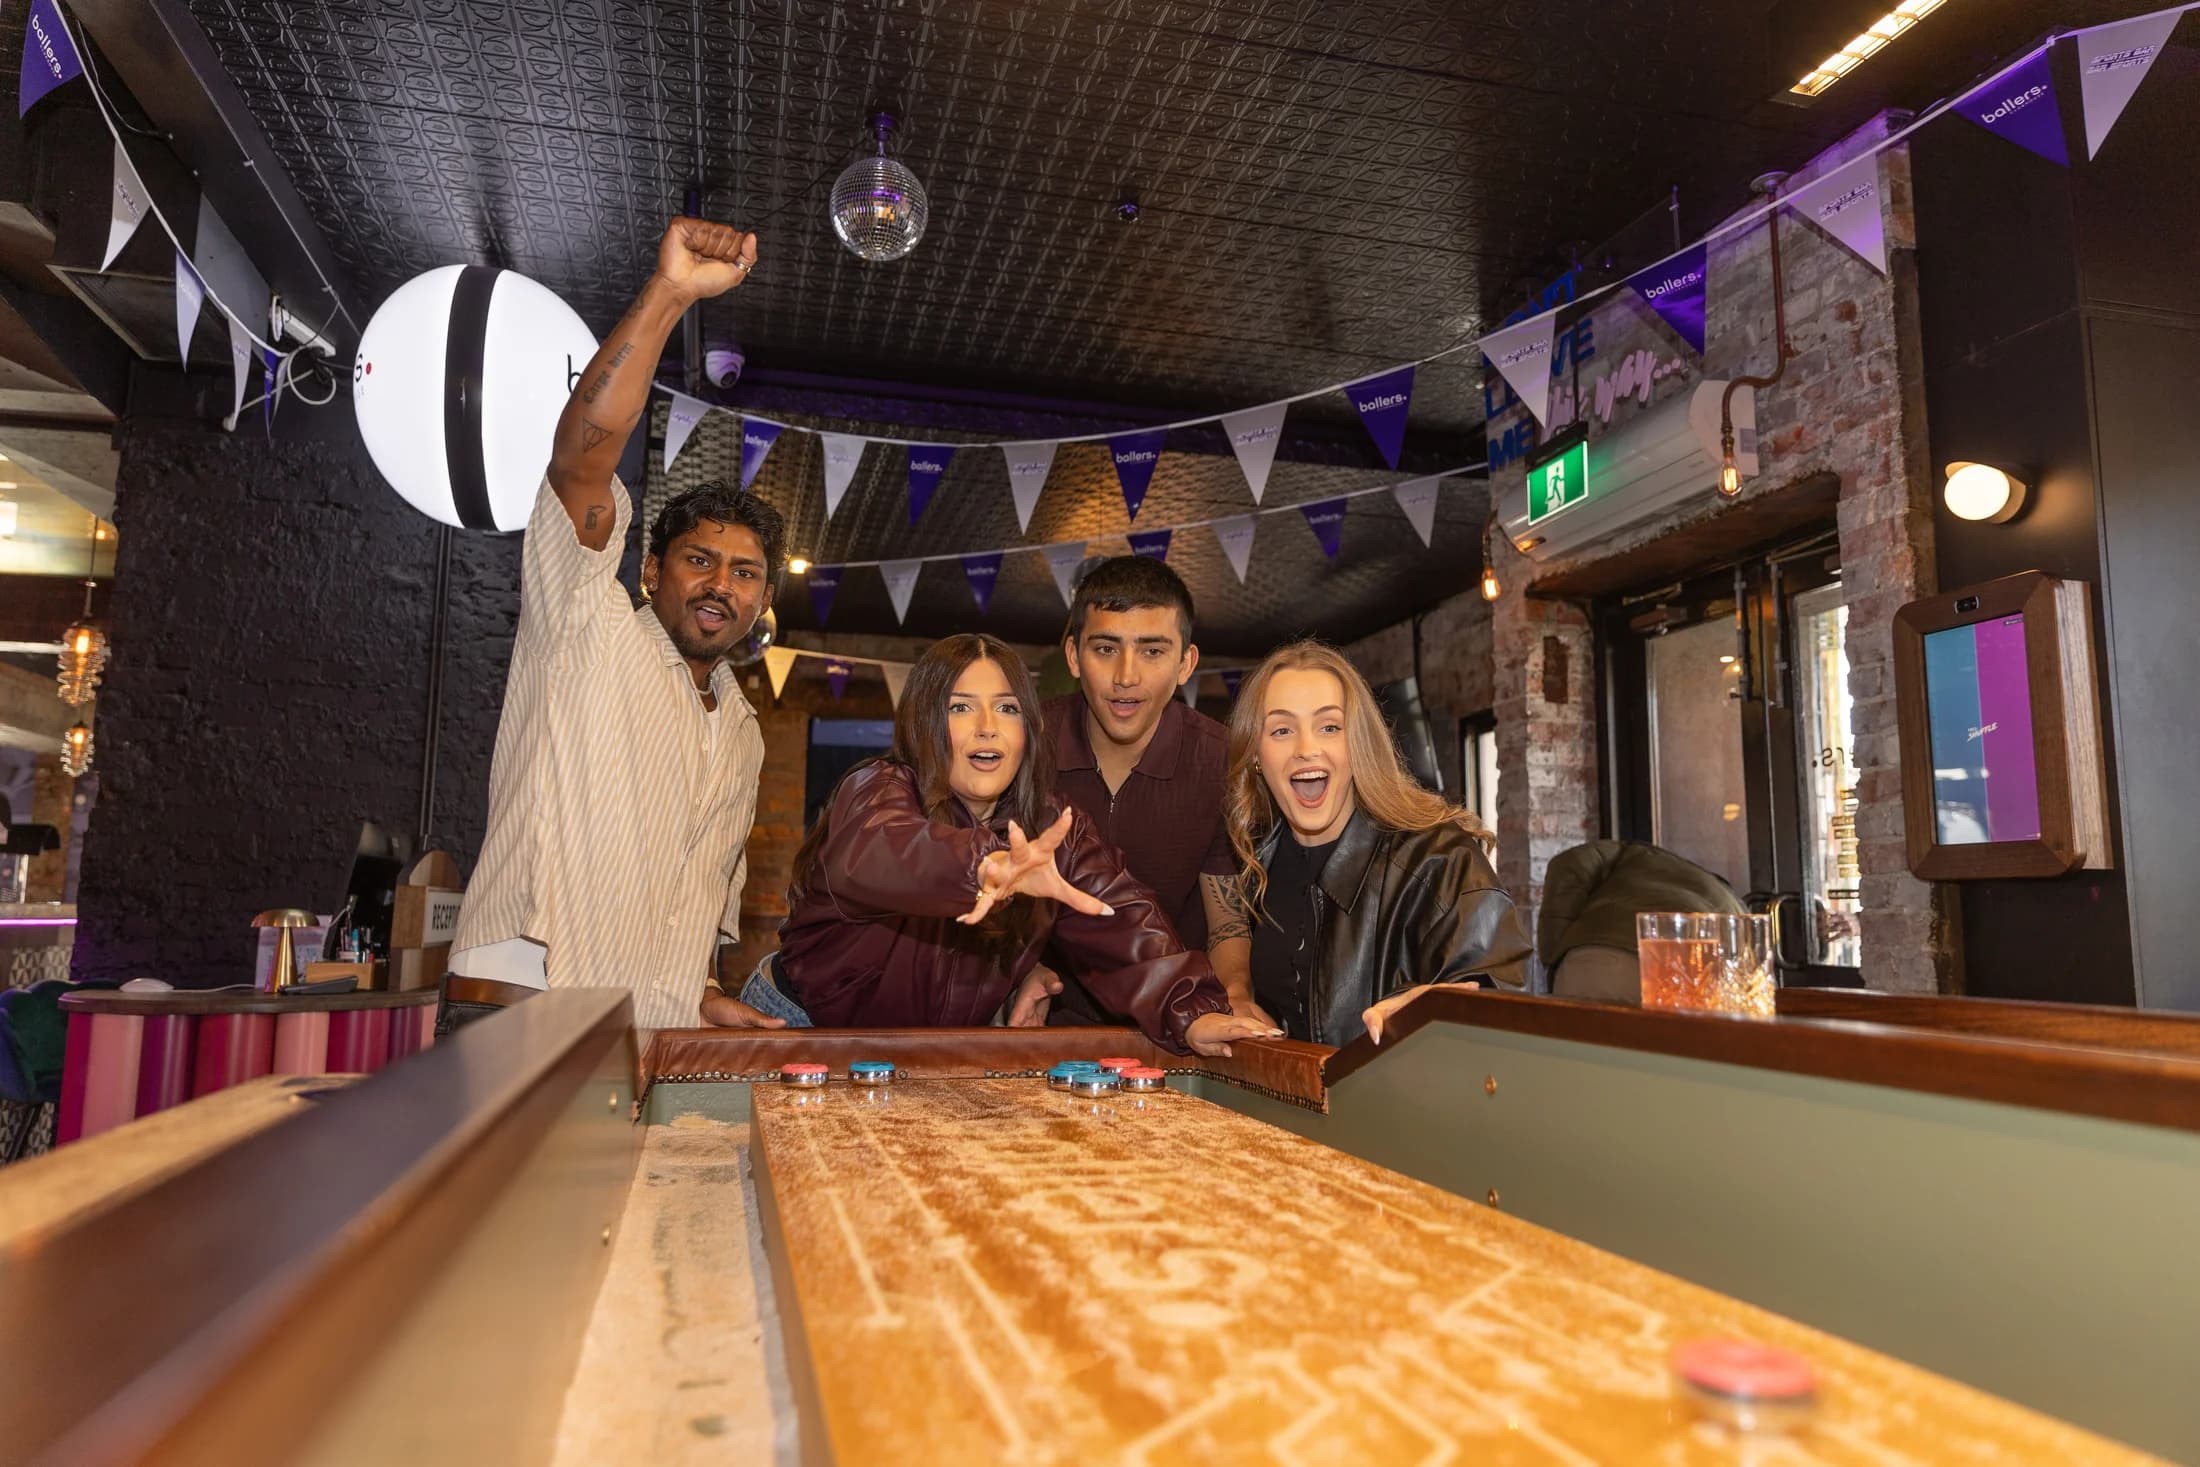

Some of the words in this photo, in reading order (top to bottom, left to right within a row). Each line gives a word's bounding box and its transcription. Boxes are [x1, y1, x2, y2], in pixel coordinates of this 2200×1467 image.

[32, 14, 62, 79] ballers.
[1981, 85, 2048, 123] ballers.
[1645, 273, 1702, 298] ballers.
[1359, 393, 1407, 413] ballers.
[1116, 450, 1156, 463] ballers.
[1488, 418, 1534, 473] ME
[911, 460, 943, 472] ballers.
